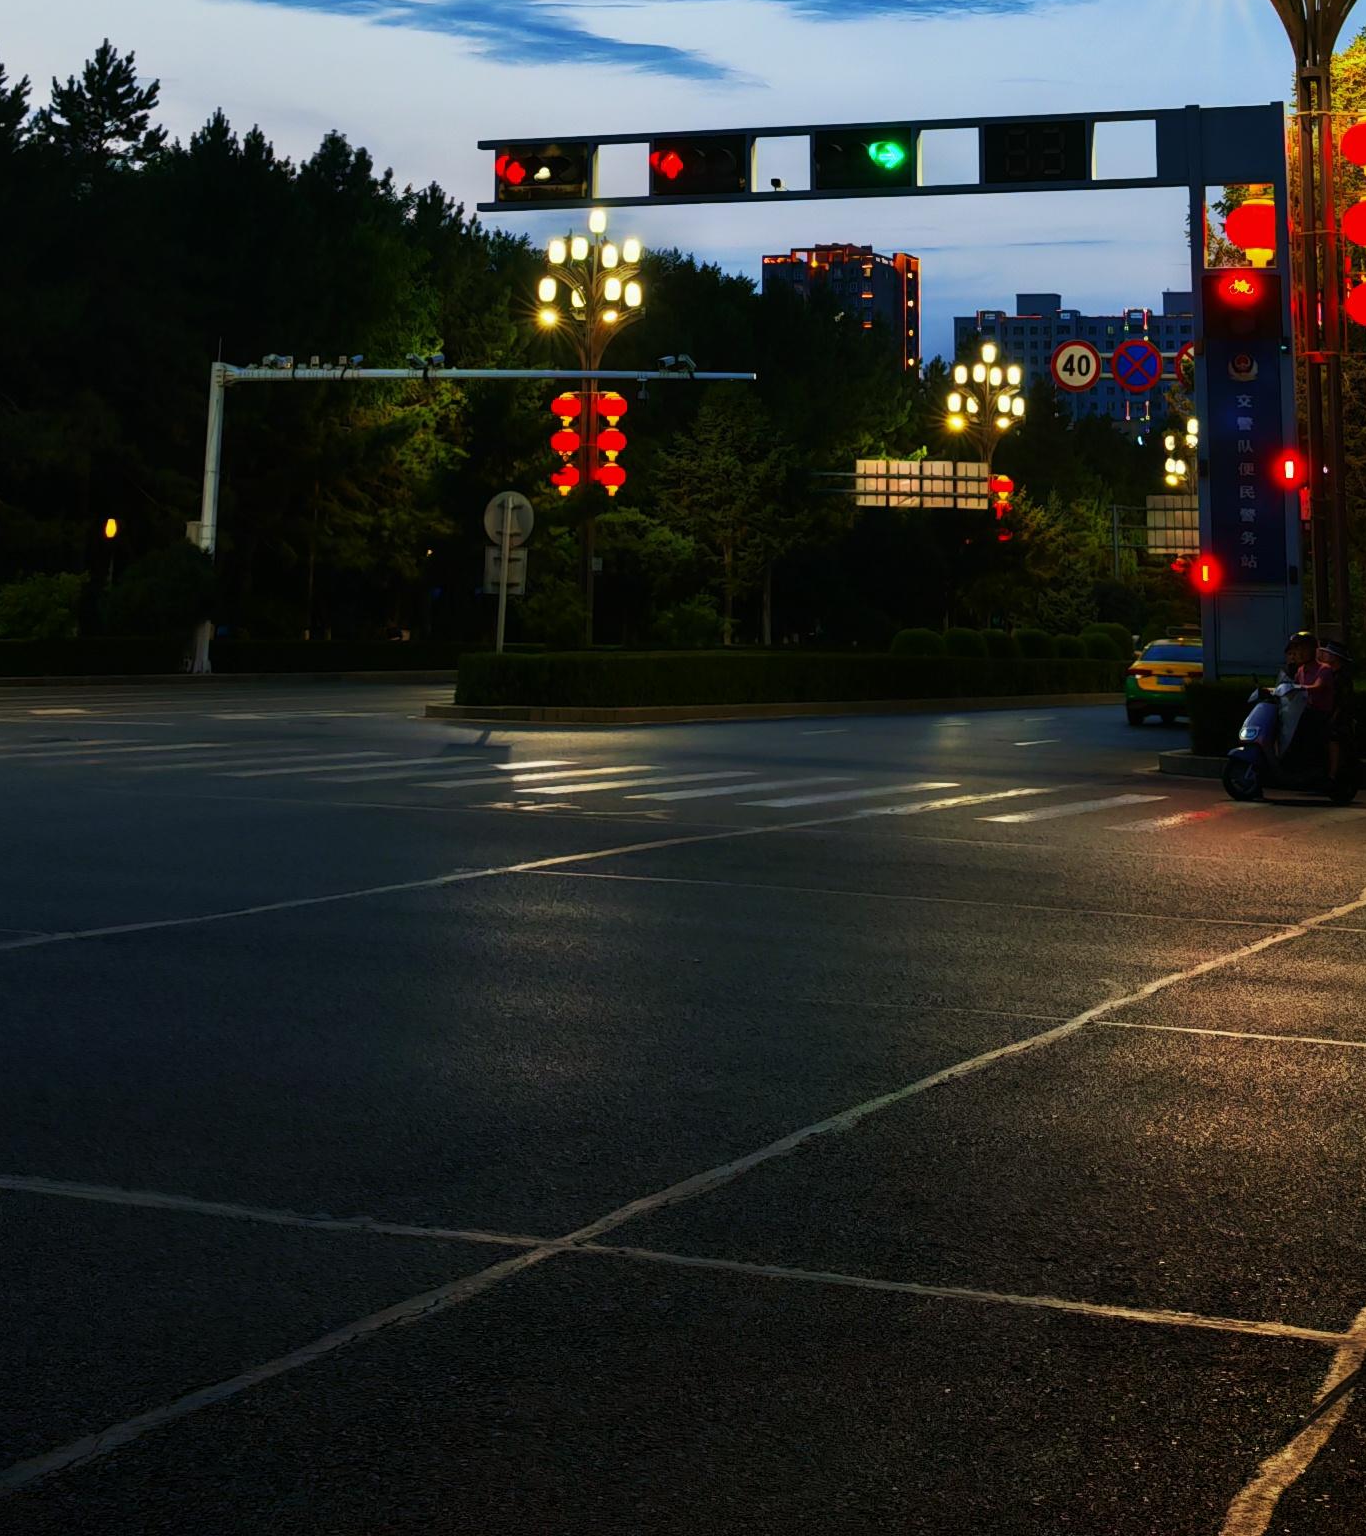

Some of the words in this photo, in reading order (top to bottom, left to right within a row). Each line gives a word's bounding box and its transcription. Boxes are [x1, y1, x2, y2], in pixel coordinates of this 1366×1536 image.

[1062, 354, 1090, 376] 40
[1235, 394, 1259, 568] 交警队便民警务站
